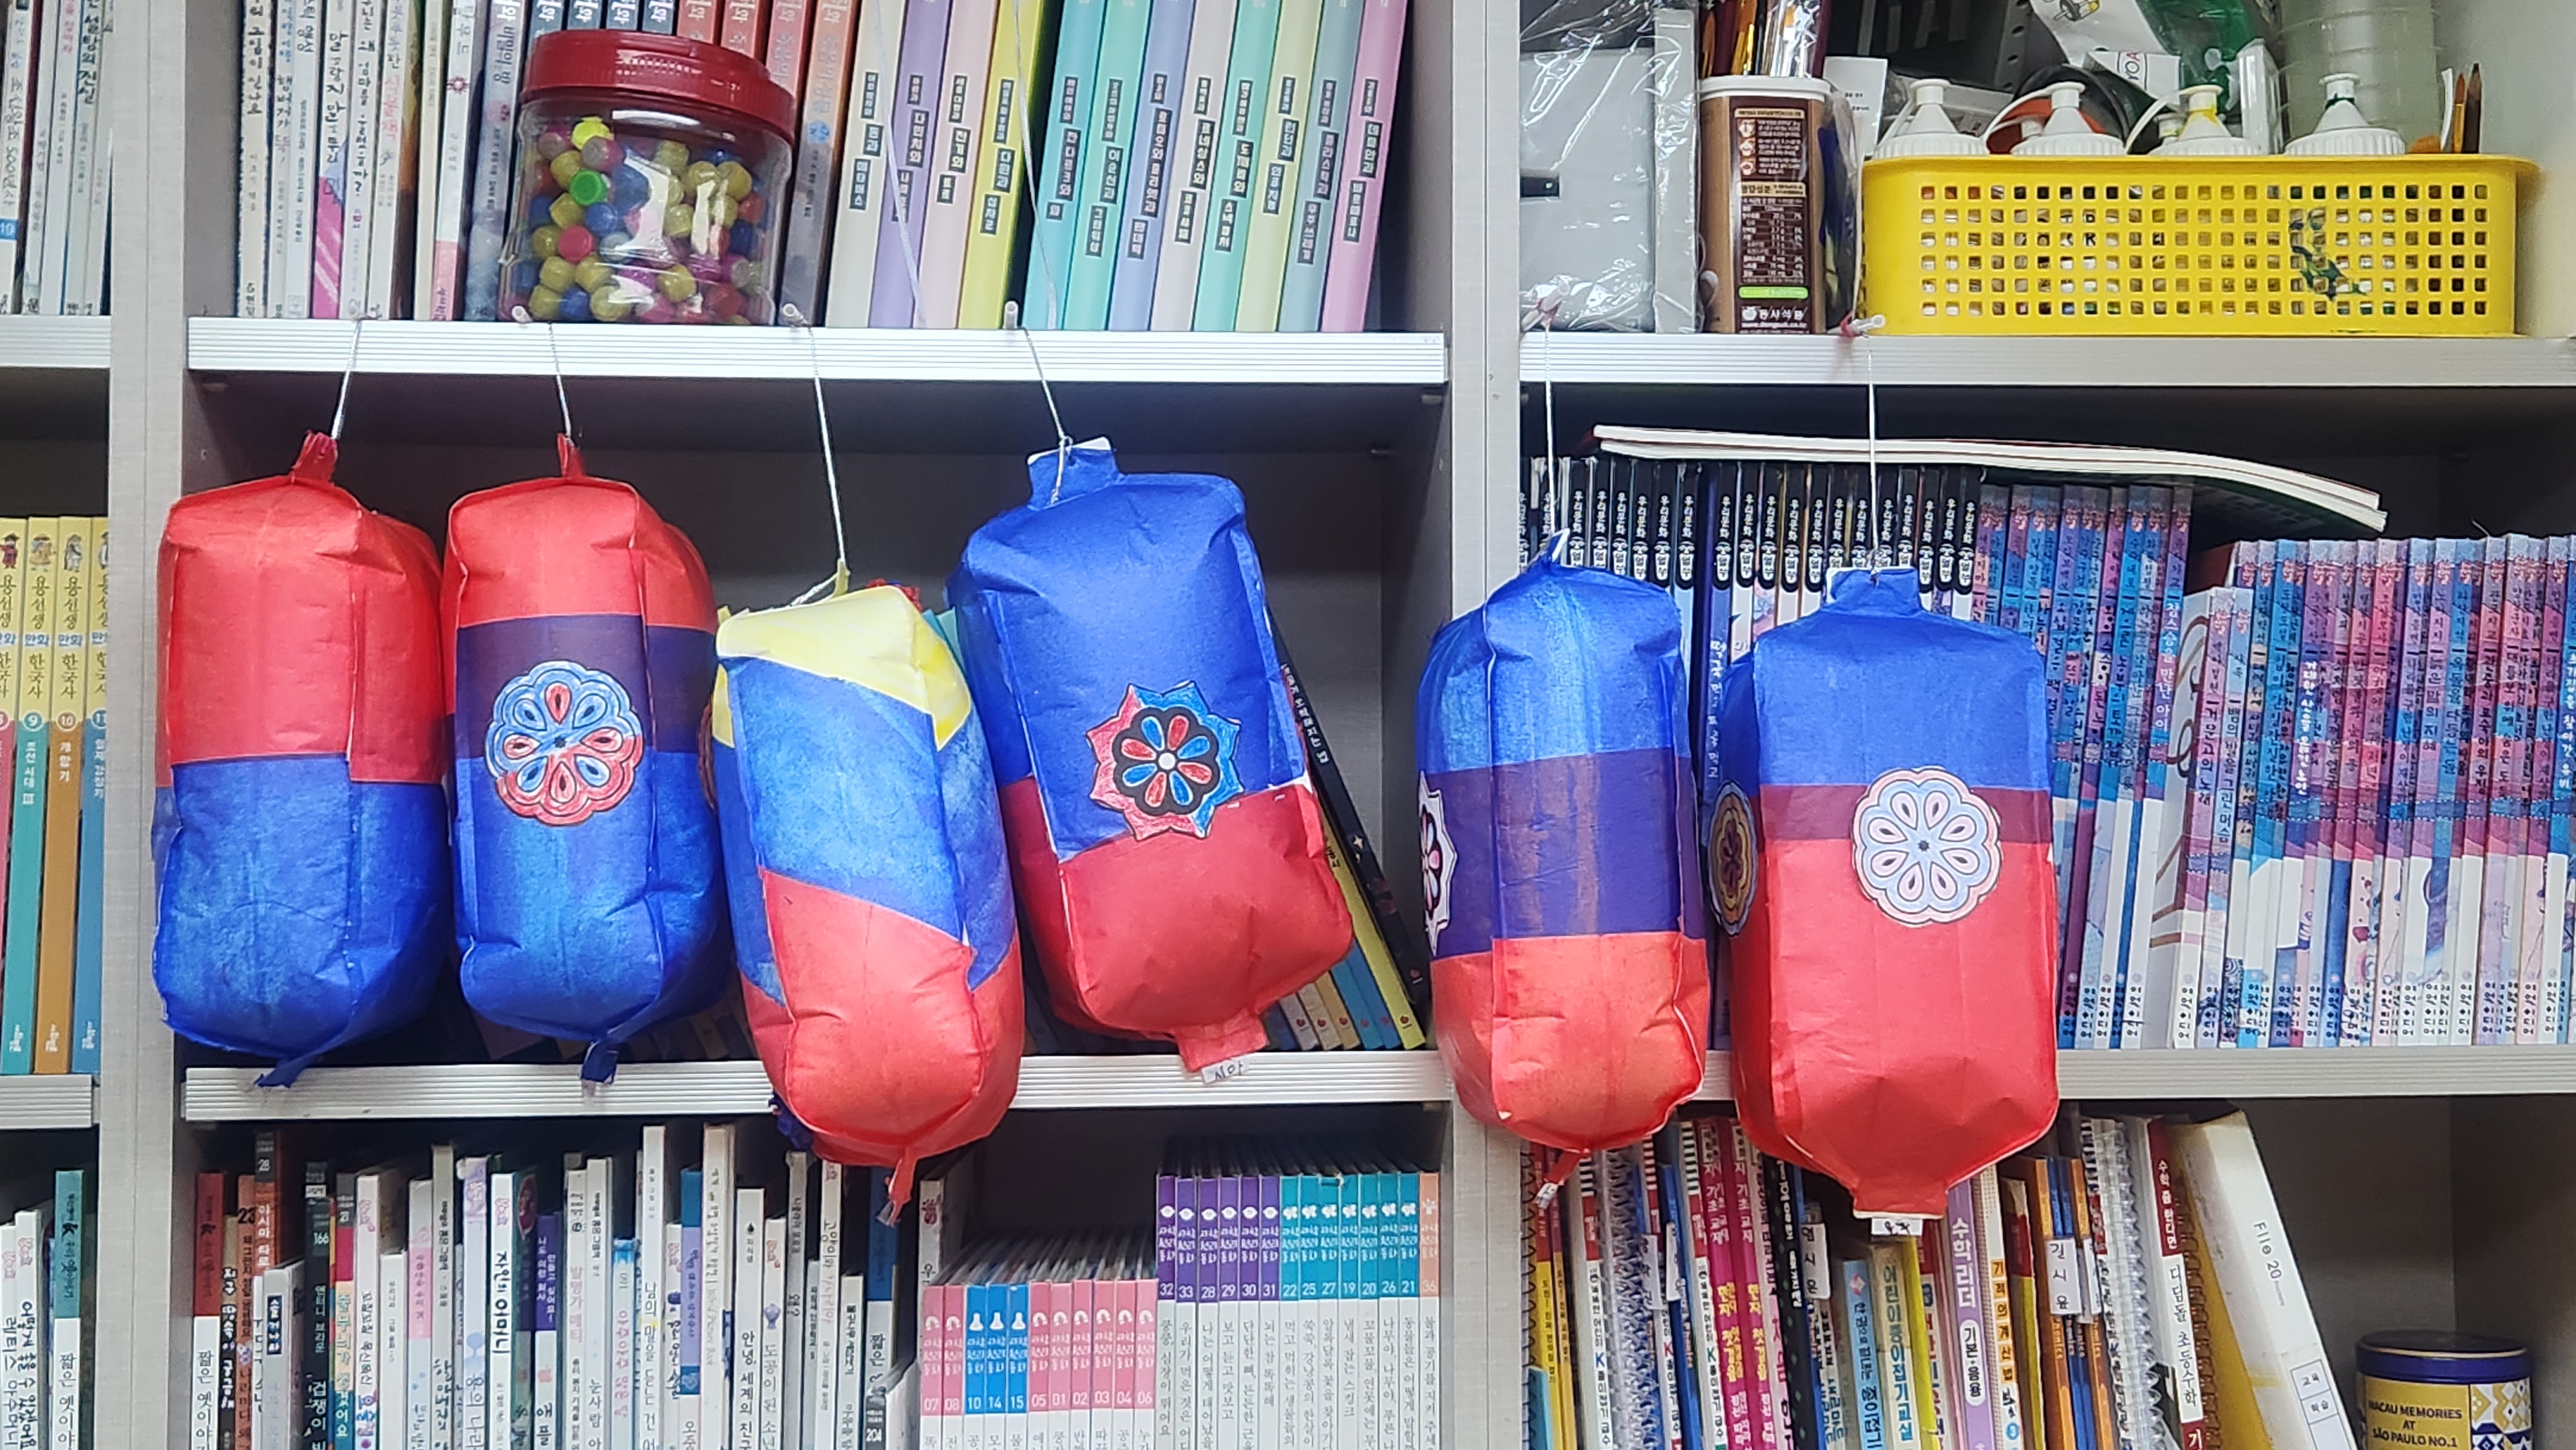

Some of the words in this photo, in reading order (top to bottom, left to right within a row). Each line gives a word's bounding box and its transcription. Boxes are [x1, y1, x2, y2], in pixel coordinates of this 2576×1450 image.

[495, 26, 515, 66] 비밀의
[31, 575, 50, 630] 용선생
[64, 576, 82, 630] 용선생
[25, 634, 50, 646] 만화
[58, 634, 82, 646] 만화
[28, 652, 46, 700] 한국사
[61, 652, 78, 700] 한국사
[2155, 667, 2175, 699] 만난
[28, 714, 38, 726] 9
[61, 715, 74, 727] 10
[2154, 704, 2171, 732] 아이
[59, 741, 71, 783] 개항기
[23, 766, 35, 788] 시대
[238, 1207, 256, 1224] 23
[314, 1230, 330, 1246] 166
[821, 1219, 837, 1268] 고양이와
[2253, 1221, 2273, 1256] File
[2266, 1260, 2284, 1280] 20
[1951, 1218, 1977, 1308] 수학리더
[222, 1266, 238, 1296] 지구
[1159, 1283, 1174, 1295] 32
[1179, 1286, 1194, 1299] 33
[1201, 1286, 1216, 1299] 28
[1221, 1285, 1236, 1297] 29
[1242, 1284, 1256, 1296] 30
[1263, 1284, 1276, 1296] 31
[1282, 1285, 1298, 1296] 22
[1302, 1283, 1316, 1295] 25
[1321, 1283, 1336, 1295] 27
[1343, 1283, 1356, 1295] 19
[1362, 1283, 1377, 1295] 20
[1381, 1281, 1397, 1294] 26
[1401, 1281, 1415, 1294] 21
[1993, 1261, 2009, 1319] 기적의
[644, 1281, 658, 1317] 남의
[788, 1293, 800, 1317] 왜?
[2169, 1264, 2188, 1324] 디딤돌
[20, 1301, 35, 1346] 어떻게
[493, 1298, 512, 1354] 어머니
[1202, 1321, 1214, 1348] 나는
[1222, 1321, 1235, 1345] 보고
[1264, 1320, 1276, 1346] 뇌는
[3, 1317, 18, 1370] 레티스
[616, 1309, 630, 1370] 아주아주
[1179, 1321, 1192, 1361] 우리가
[1243, 1319, 1255, 1361] 단단한
[59, 1353, 77, 1388] 짧은
[195, 1350, 214, 1385] 짧은
[1160, 1351, 1171, 1393] 심장이
[1180, 1364, 1191, 1392] 먹은
[2177, 1330, 2198, 1408] 초등수학
[19, 1377, 35, 1388] 수
[220, 1359, 236, 1410] 궁금해
[739, 1370, 754, 1416] 세계의
[311, 1379, 327, 1428] 겁쟁이
[588, 1379, 601, 1429] 눈사람
[924, 1397, 940, 1410] 07
[968, 1396, 982, 1409] 10
[988, 1396, 1002, 1409] 14
[1010, 1395, 1024, 1409] 15
[1032, 1393, 1046, 1407] 05
[1052, 1393, 1066, 1406] 01
[1073, 1392, 1088, 1406] 02
[1094, 1391, 1110, 1404] 03
[1117, 1391, 1132, 1404] 04
[1137, 1391, 1153, 1404] 06
[1222, 1380, 1235, 1420] 맛보고
[2369, 1400, 2398, 1415] MACAU
[2400, 1404, 2463, 1419] MEMORIES
[58, 1395, 76, 1450] 옛이야
[194, 1393, 214, 1450] 옛이야
[536, 1402, 553, 1447] 애플
[1861, 1386, 1884, 1450] 종이접기
[2402, 1420, 2417, 1431] AT
[866, 1427, 883, 1443] 204
[2391, 1433, 2427, 1446] PAULO
[2429, 1435, 2459, 1447] NO.1
